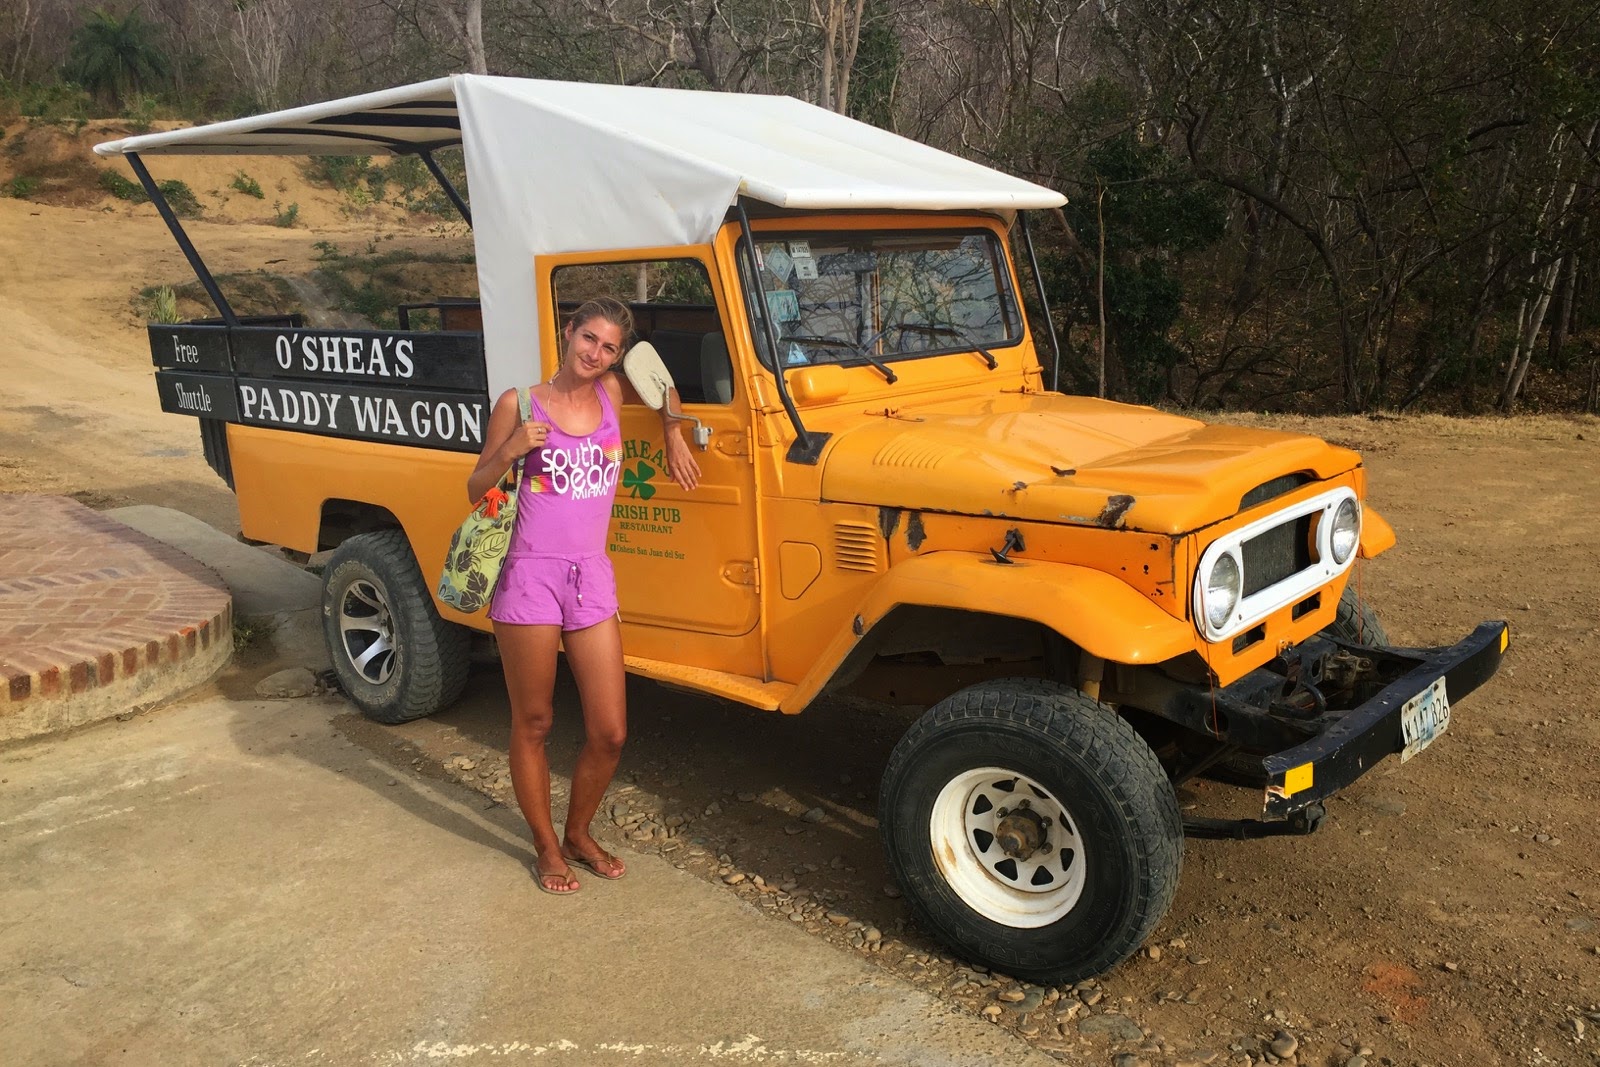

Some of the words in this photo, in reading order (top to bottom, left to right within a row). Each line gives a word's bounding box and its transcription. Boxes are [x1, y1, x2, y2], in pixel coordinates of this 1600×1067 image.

[172, 334, 199, 363] Free
[175, 382, 212, 412] Shuttle
[239, 385, 341, 429] PADDY
[349, 395, 482, 443] WAGON
[621, 439, 671, 478] HEA
[611, 504, 649, 521] IRISH
[652, 507, 681, 523] PUB
[619, 521, 673, 534] RESTAURANT
[649, 548, 664, 558] Juan
[664, 550, 674, 559] del
